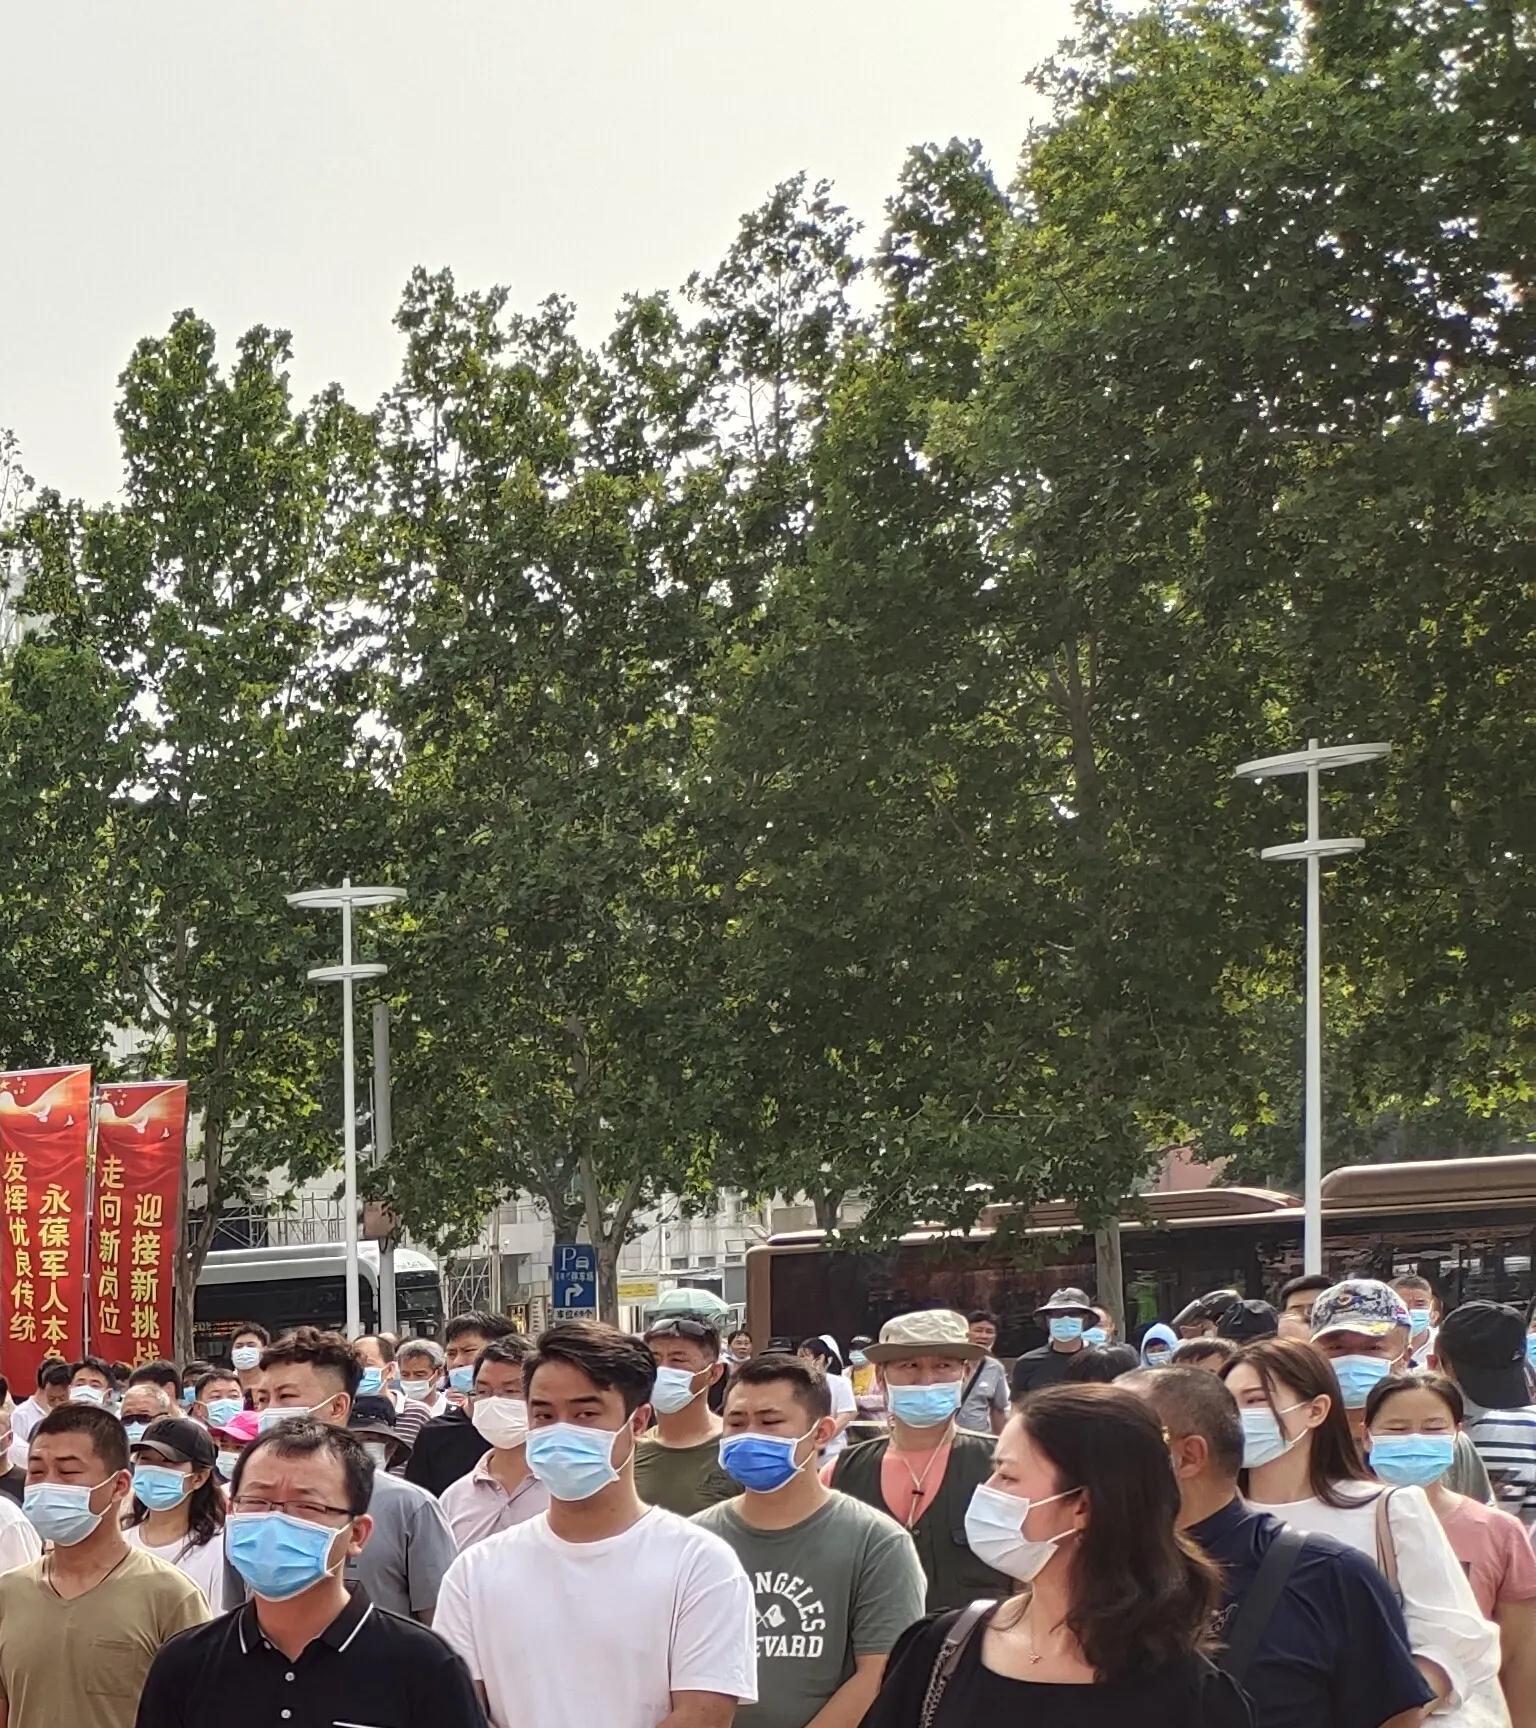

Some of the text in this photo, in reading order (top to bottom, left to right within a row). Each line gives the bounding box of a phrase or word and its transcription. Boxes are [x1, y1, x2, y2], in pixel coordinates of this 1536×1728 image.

[3, 1152, 37, 1344] 发挥优良传统
[98, 1154, 126, 1335] 走向新岗位
[560, 1247, 577, 1271] P
[755, 1571, 825, 1632] NGELES
[756, 1635, 824, 1657] EVARD
